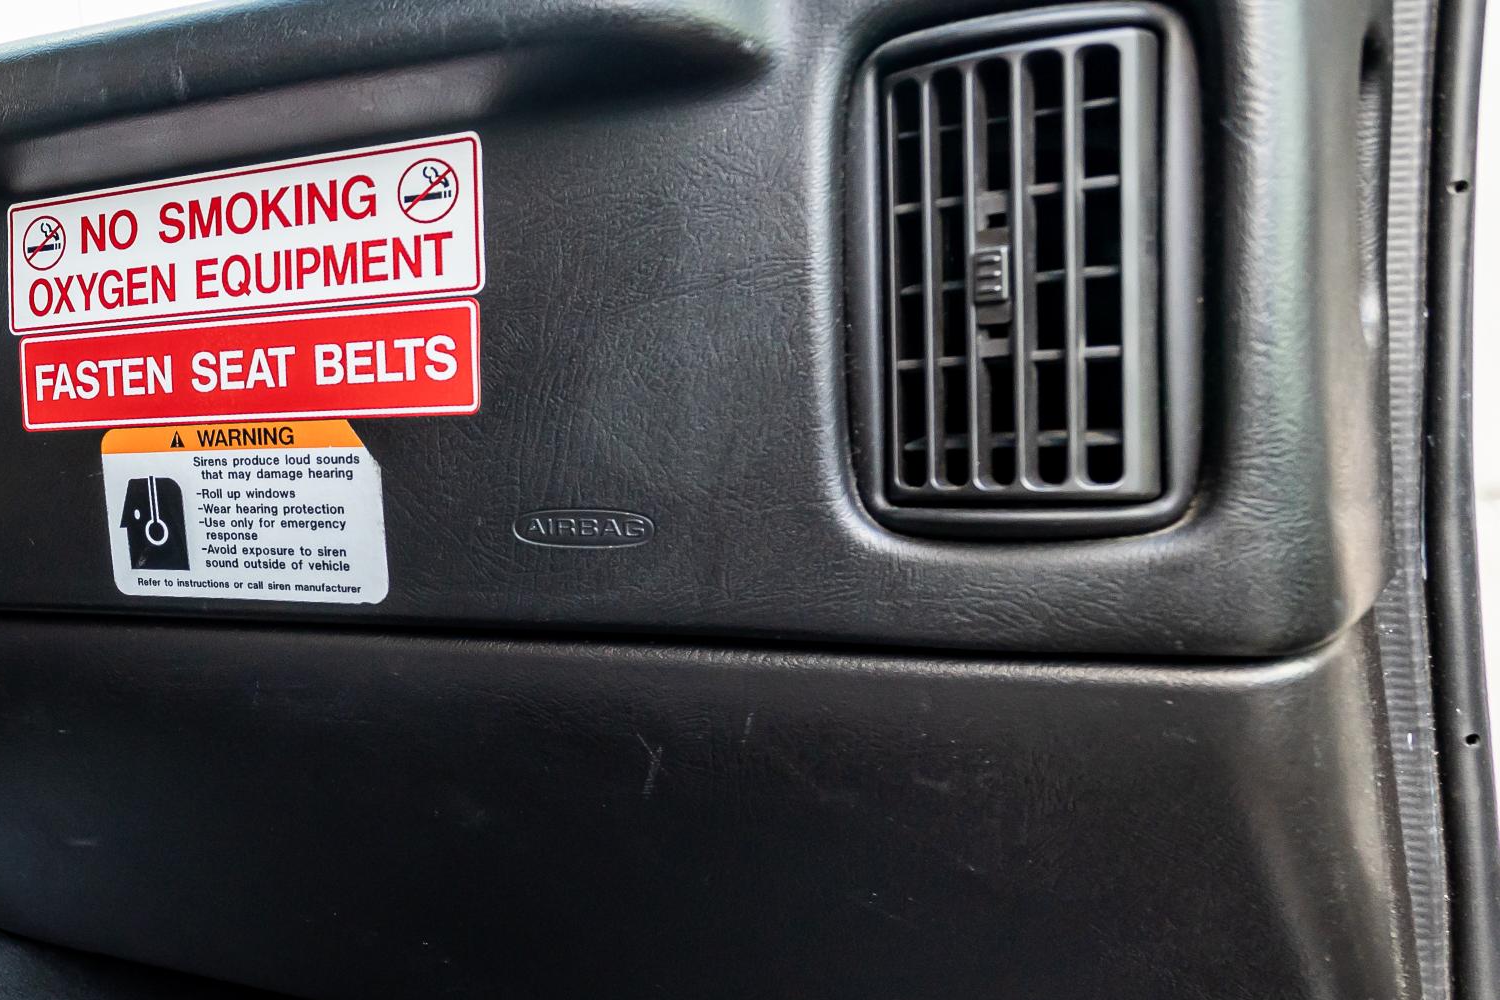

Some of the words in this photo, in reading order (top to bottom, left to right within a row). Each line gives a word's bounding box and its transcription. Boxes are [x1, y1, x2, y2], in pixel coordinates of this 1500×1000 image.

[81, 209, 138, 254] NO
[159, 175, 376, 244] SMOKING
[29, 263, 176, 317] OXYGEN
[196, 231, 453, 298] EQUIPMENT
[34, 355, 173, 402] FASTEN
[191, 346, 297, 393] SEAT
[315, 334, 459, 386] BELTS
[197, 427, 294, 447] WARNING
[193, 454, 228, 467] Sirens
[232, 454, 280, 468] produce
[285, 453, 311, 466] loud
[316, 453, 360, 465] sounds
[201, 468, 224, 480] that
[227, 470, 251, 482] may
[256, 468, 303, 481] damage
[308, 467, 354, 481] hearing
[226, 490, 241, 501] up
[245, 487, 296, 499] windows
[235, 503, 279, 517] hearing
[282, 503, 345, 516] protection
[230, 517, 254, 530] only
[258, 517, 276, 528] for
[280, 519, 347, 532] emergency
[528, 518, 646, 537] AIRBAG
[206, 531, 258, 543] response
[241, 546, 295, 558] exposure
[299, 545, 312, 557] to
[317, 545, 347, 558] siren
[205, 557, 239, 569] sound
[243, 558, 286, 570] outside
[290, 559, 304, 570] of
[308, 559, 350, 572] vehicle
[137, 577, 161, 587] Refer
[163, 578, 174, 587] to
[176, 578, 230, 589] instructions
[233, 581, 244, 589] or
[247, 580, 264, 590] call
[267, 581, 291, 591] siren
[294, 582, 362, 594] manufacturer
